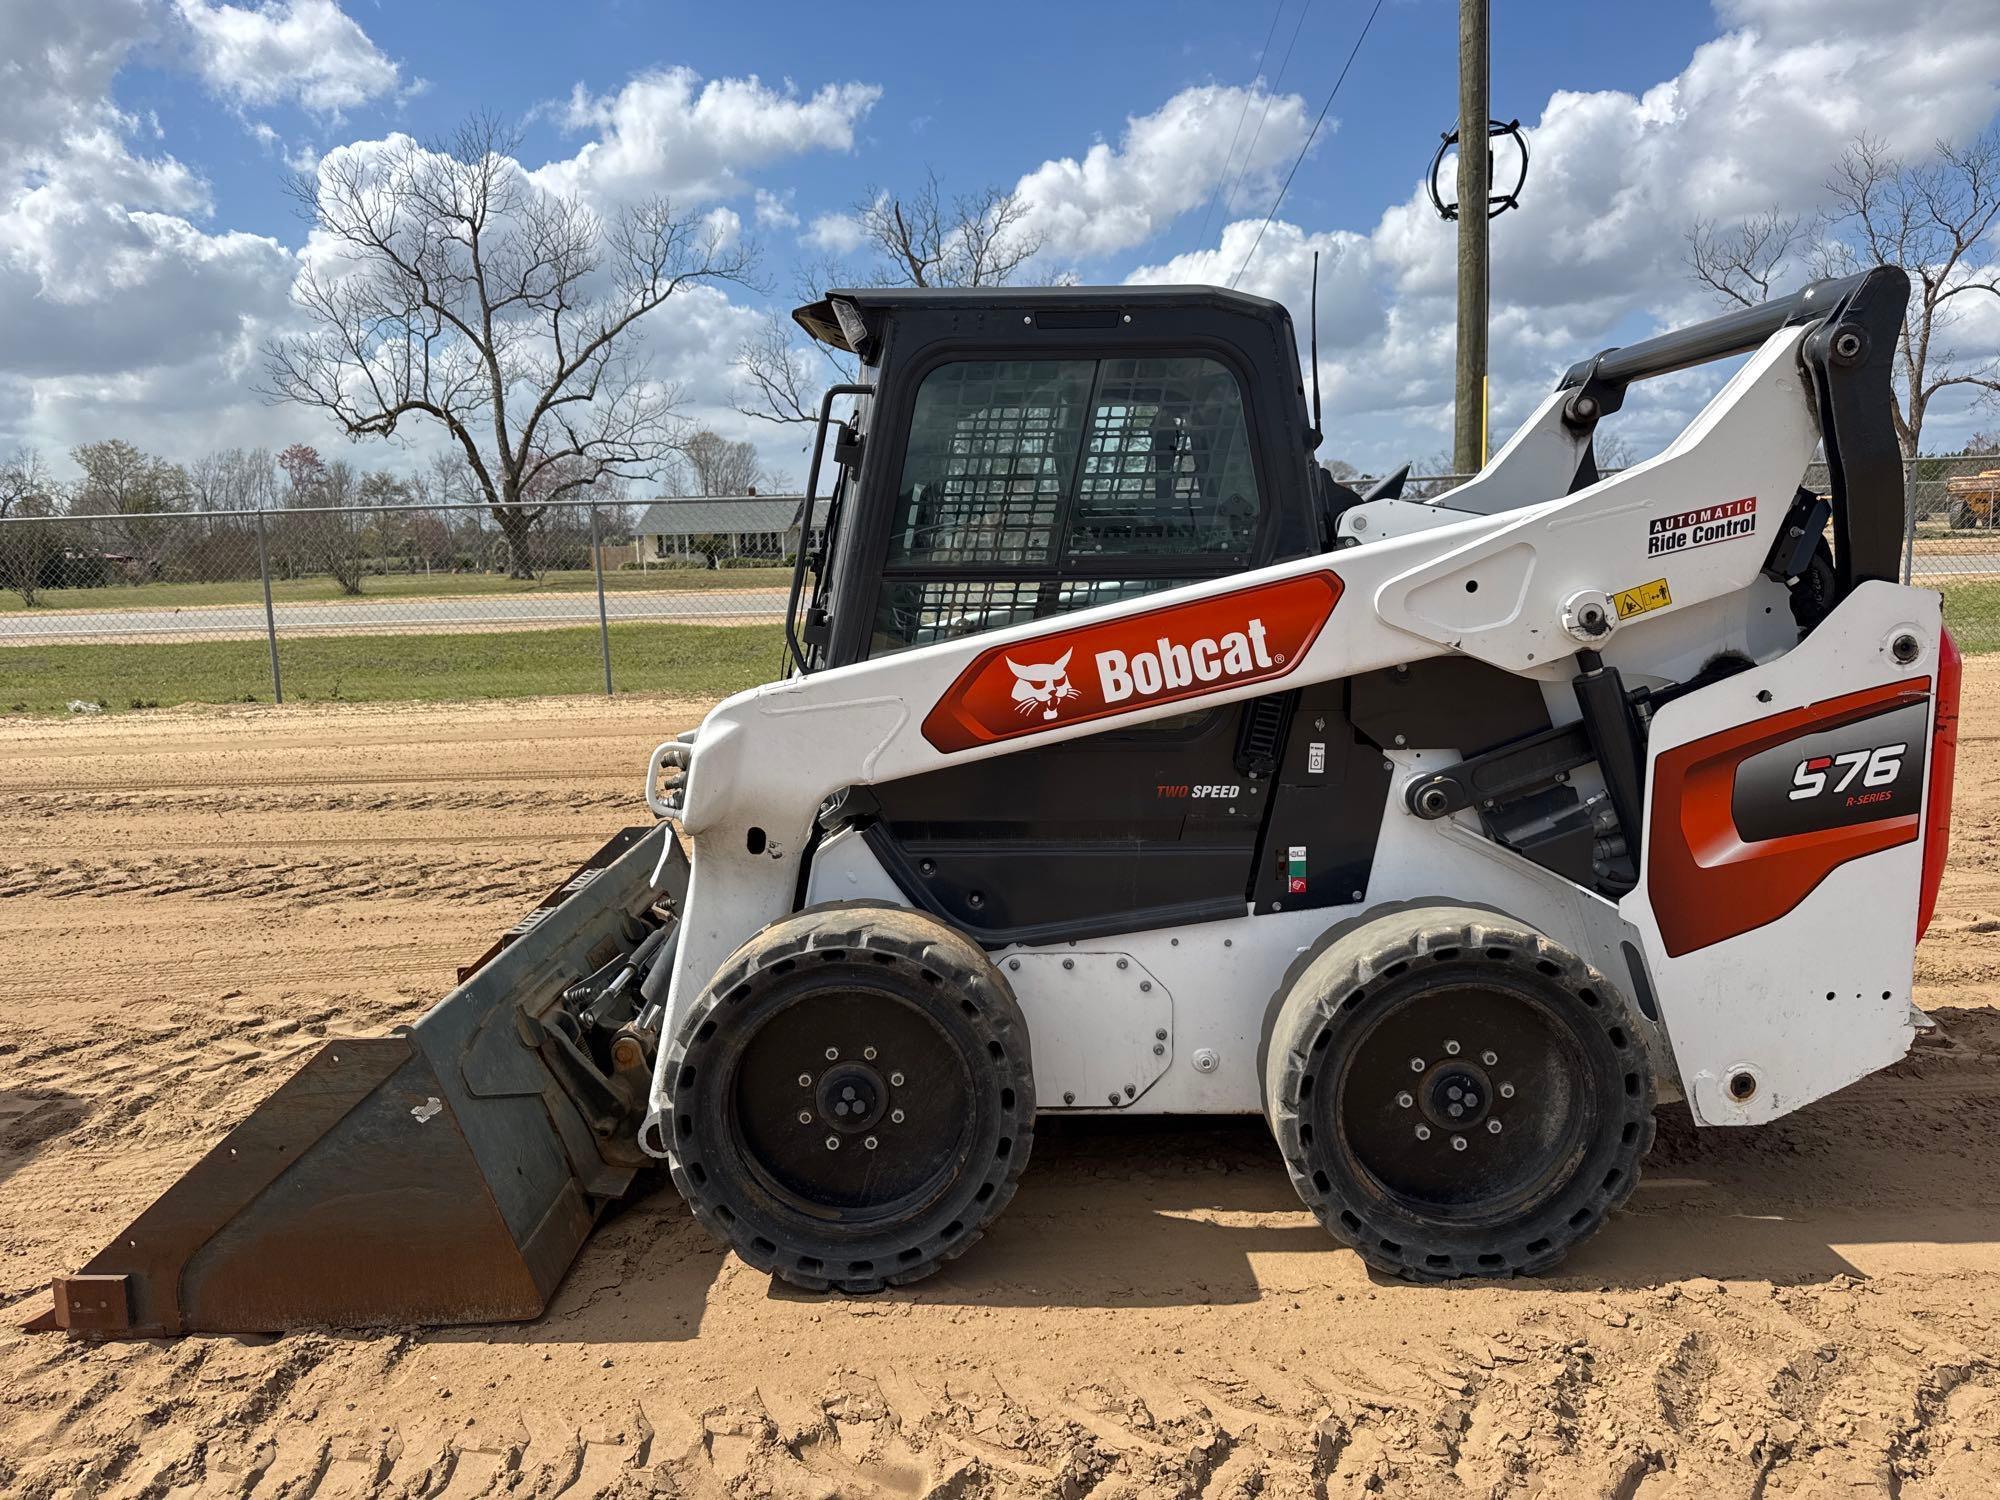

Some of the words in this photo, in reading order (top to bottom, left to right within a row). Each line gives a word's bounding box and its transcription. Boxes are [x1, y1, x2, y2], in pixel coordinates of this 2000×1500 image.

[1653, 500, 1752, 532] AUTOMATIC
[1648, 532, 1687, 554] Ride
[1693, 514, 1756, 544] Control
[1788, 743, 1907, 801] S76
[1157, 785, 1189, 798] TWO
[1191, 785, 1240, 798] SPEED
[1846, 790, 1892, 806] R-SERIES
